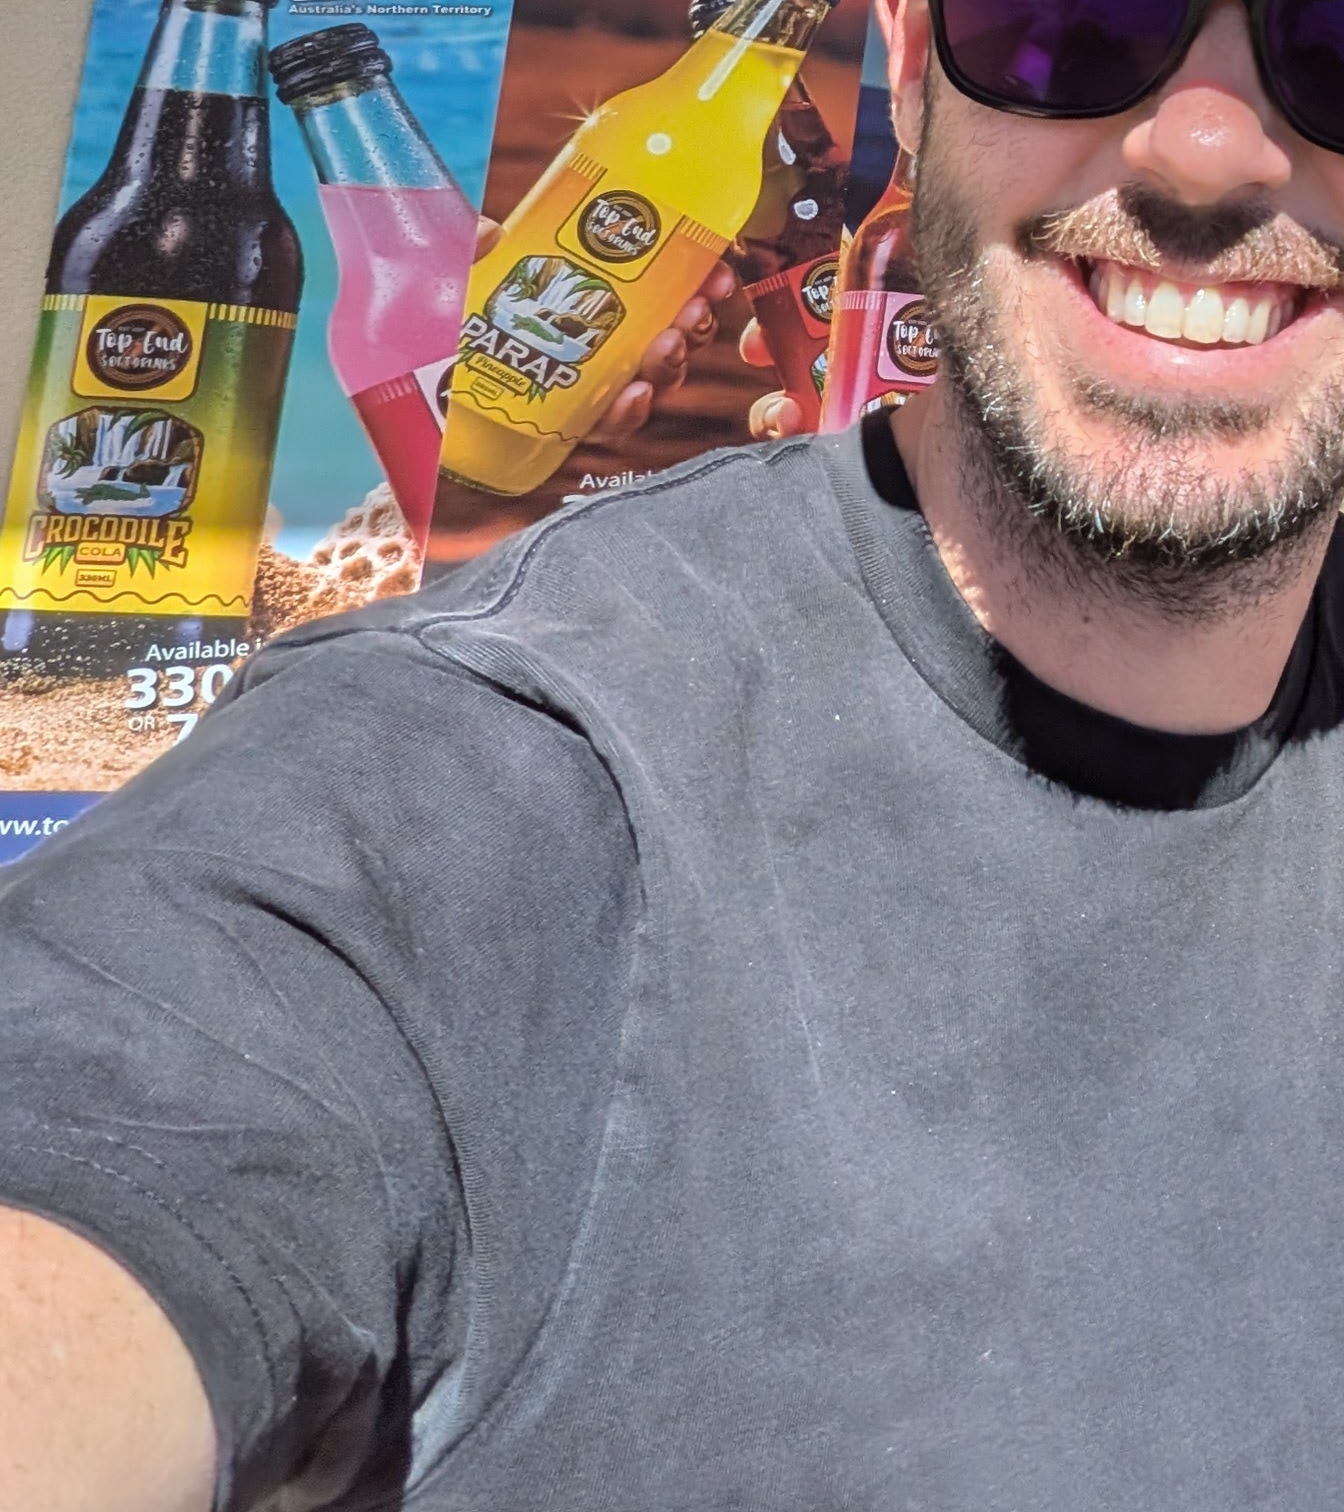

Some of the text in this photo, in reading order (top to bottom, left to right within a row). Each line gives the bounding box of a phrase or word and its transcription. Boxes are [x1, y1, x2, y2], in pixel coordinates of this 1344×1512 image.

[288, 4, 492, 16] Australia's Northern Territory
[96, 329, 189, 354] Top End
[893, 320, 919, 343] Top
[461, 315, 579, 389] PARAP
[475, 355, 527, 388] Pineapple
[24, 515, 191, 568] CROCODILE
[79, 546, 122, 556] COLA
[145, 638, 249, 661] Available
[128, 716, 156, 732] OR
